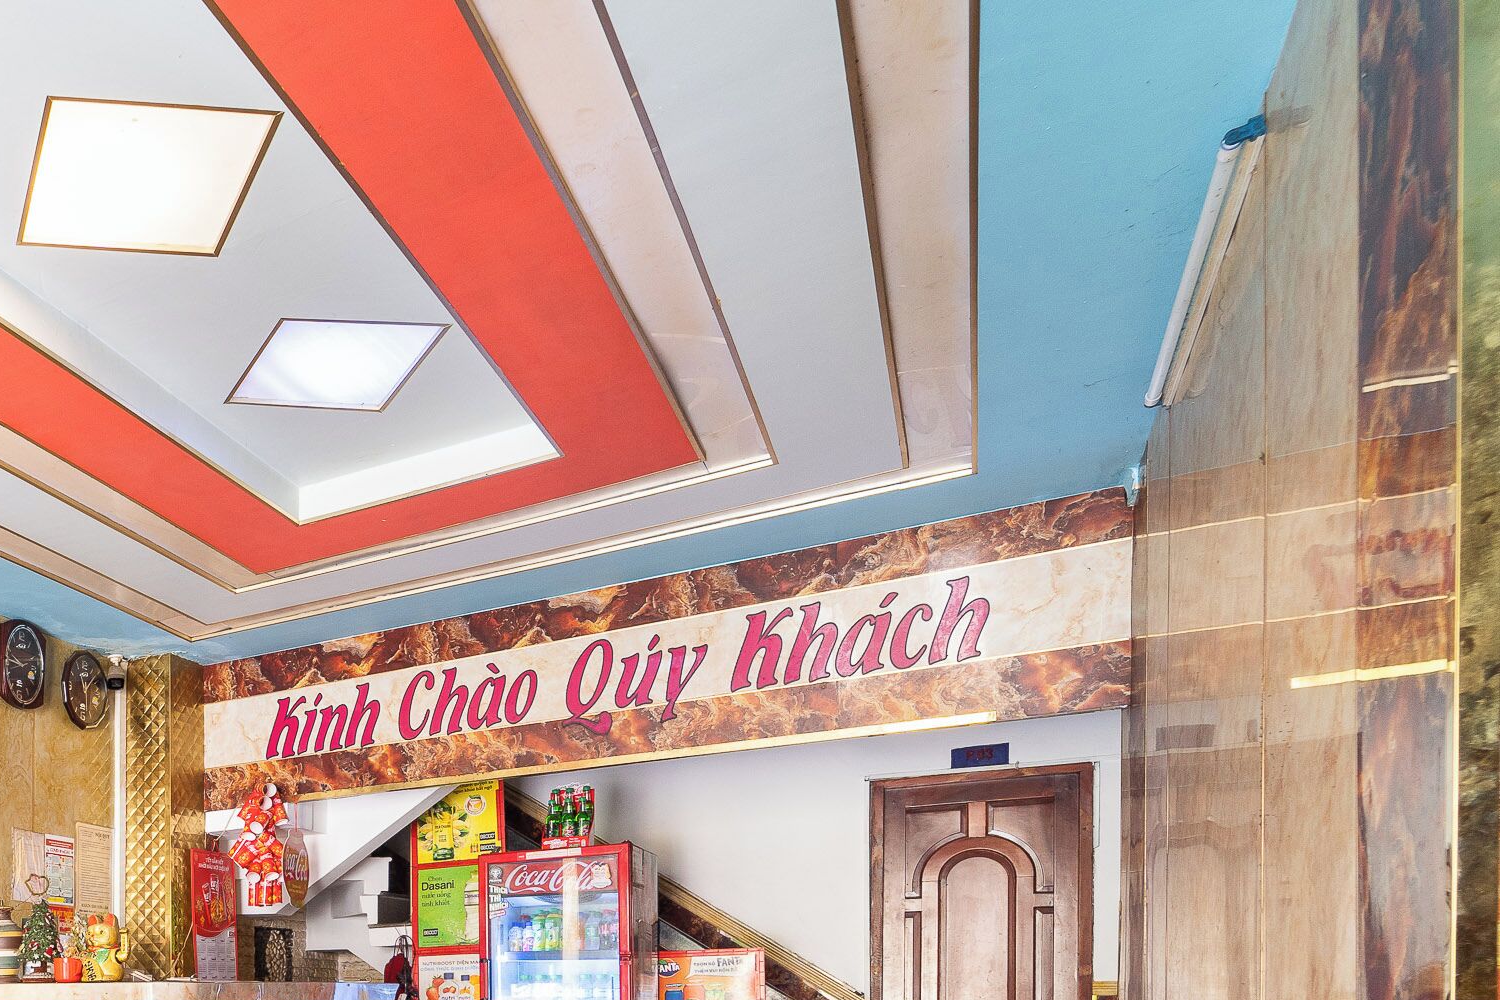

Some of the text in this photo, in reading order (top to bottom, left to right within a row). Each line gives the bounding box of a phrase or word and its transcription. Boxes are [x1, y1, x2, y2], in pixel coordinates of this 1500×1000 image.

[266, 682, 381, 760] Kính
[400, 662, 538, 741] Chào
[731, 575, 991, 692] Khách
[421, 880, 455, 891] Dasani
